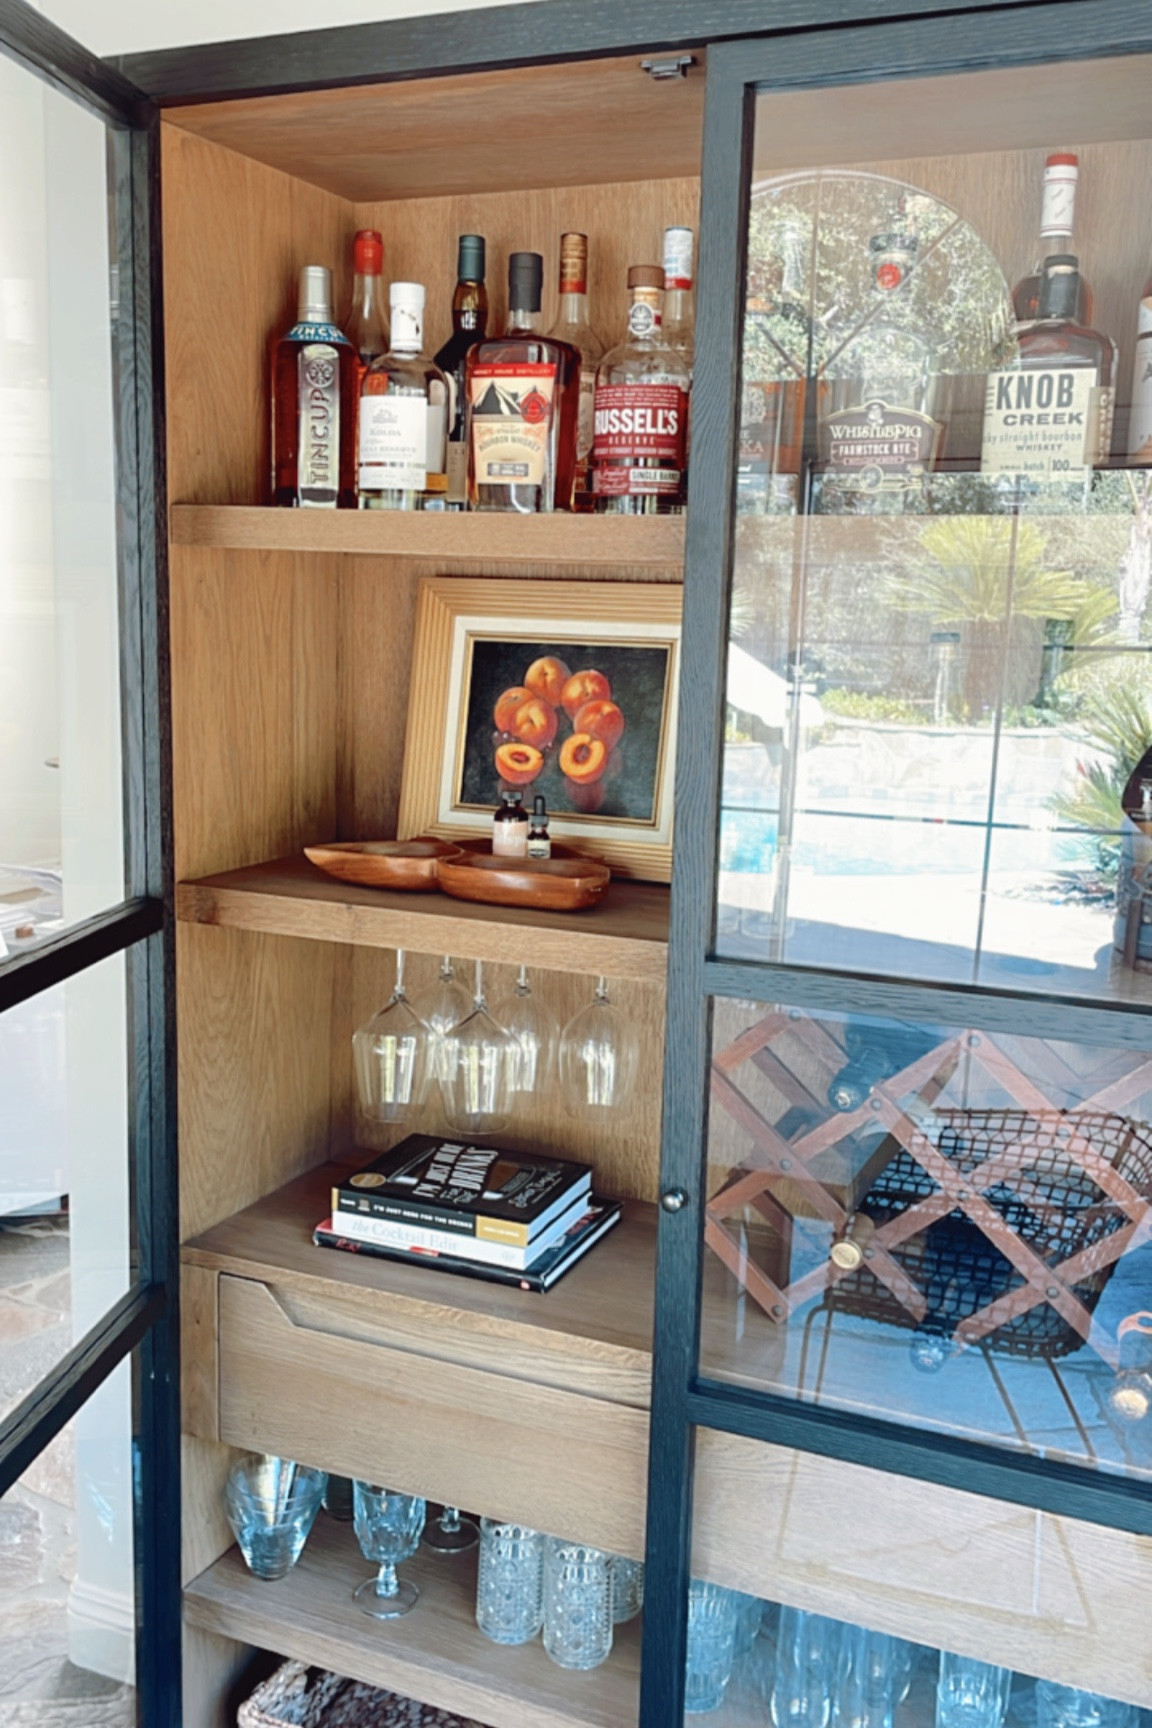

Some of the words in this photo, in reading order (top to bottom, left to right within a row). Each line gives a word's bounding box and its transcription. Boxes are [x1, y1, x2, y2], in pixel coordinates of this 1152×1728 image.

[996, 373, 1075, 411] KNOB
[594, 408, 679, 435] RUSSELL'S
[1003, 412, 1084, 426] CREEK
[310, 388, 330, 484] TINCUP
[1016, 443, 1063, 452] WHISKEY
[1052, 459, 1070, 471] 100
[385, 1206, 402, 1215] JUST
[402, 1209, 419, 1218] HERE
[420, 1213, 433, 1221] FOR
[434, 1215, 447, 1224] THE
[371, 1222, 425, 1246] Cocktail
[429, 1233, 458, 1251] Edit
